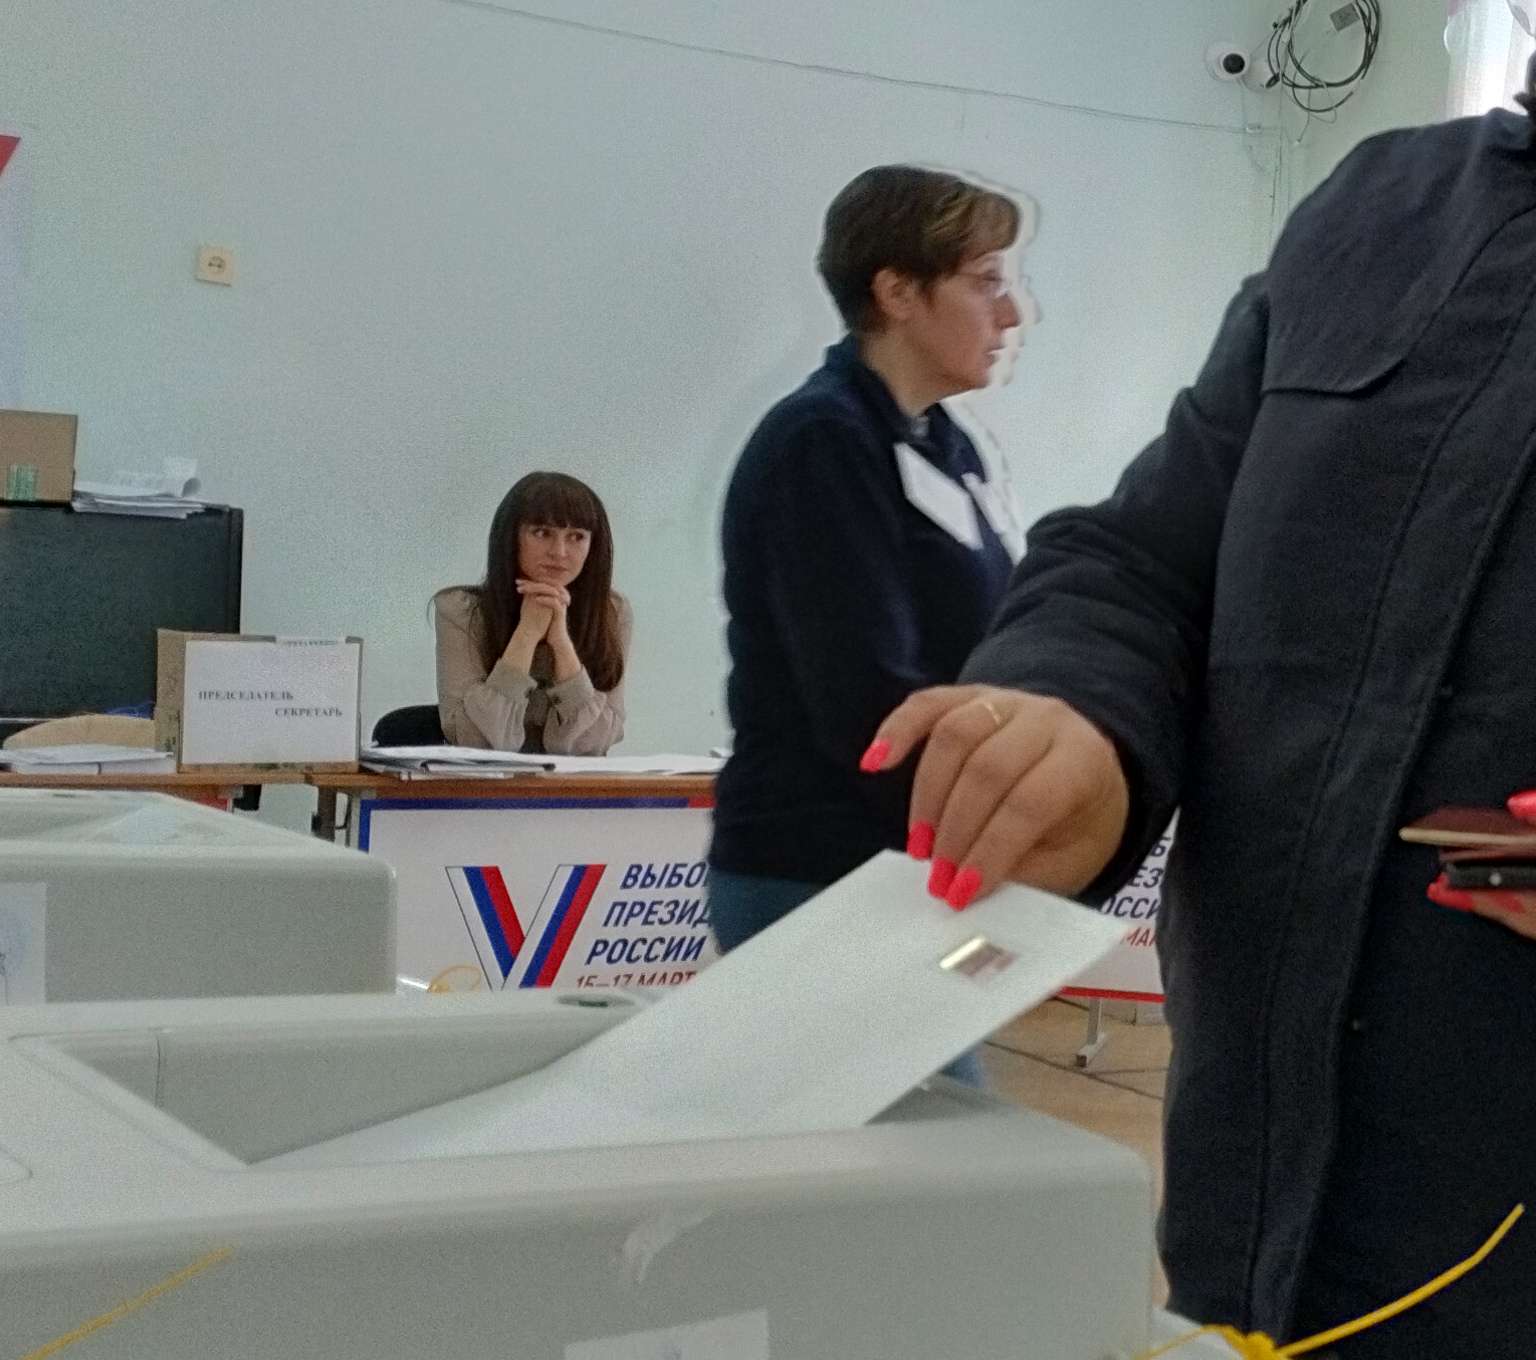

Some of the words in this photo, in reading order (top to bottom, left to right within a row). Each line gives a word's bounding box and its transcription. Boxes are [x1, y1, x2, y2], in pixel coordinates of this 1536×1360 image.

[199, 690, 294, 701] ПРЕДСЕДАТЕЛЬ
[275, 707, 342, 718] СЕКРЕТАРЬ
[620, 862, 708, 890] ВЫБО
[602, 899, 710, 929] ПРЕЗИД
[585, 936, 706, 966] РОССИИ
[636, 970, 698, 988] МАРТ
